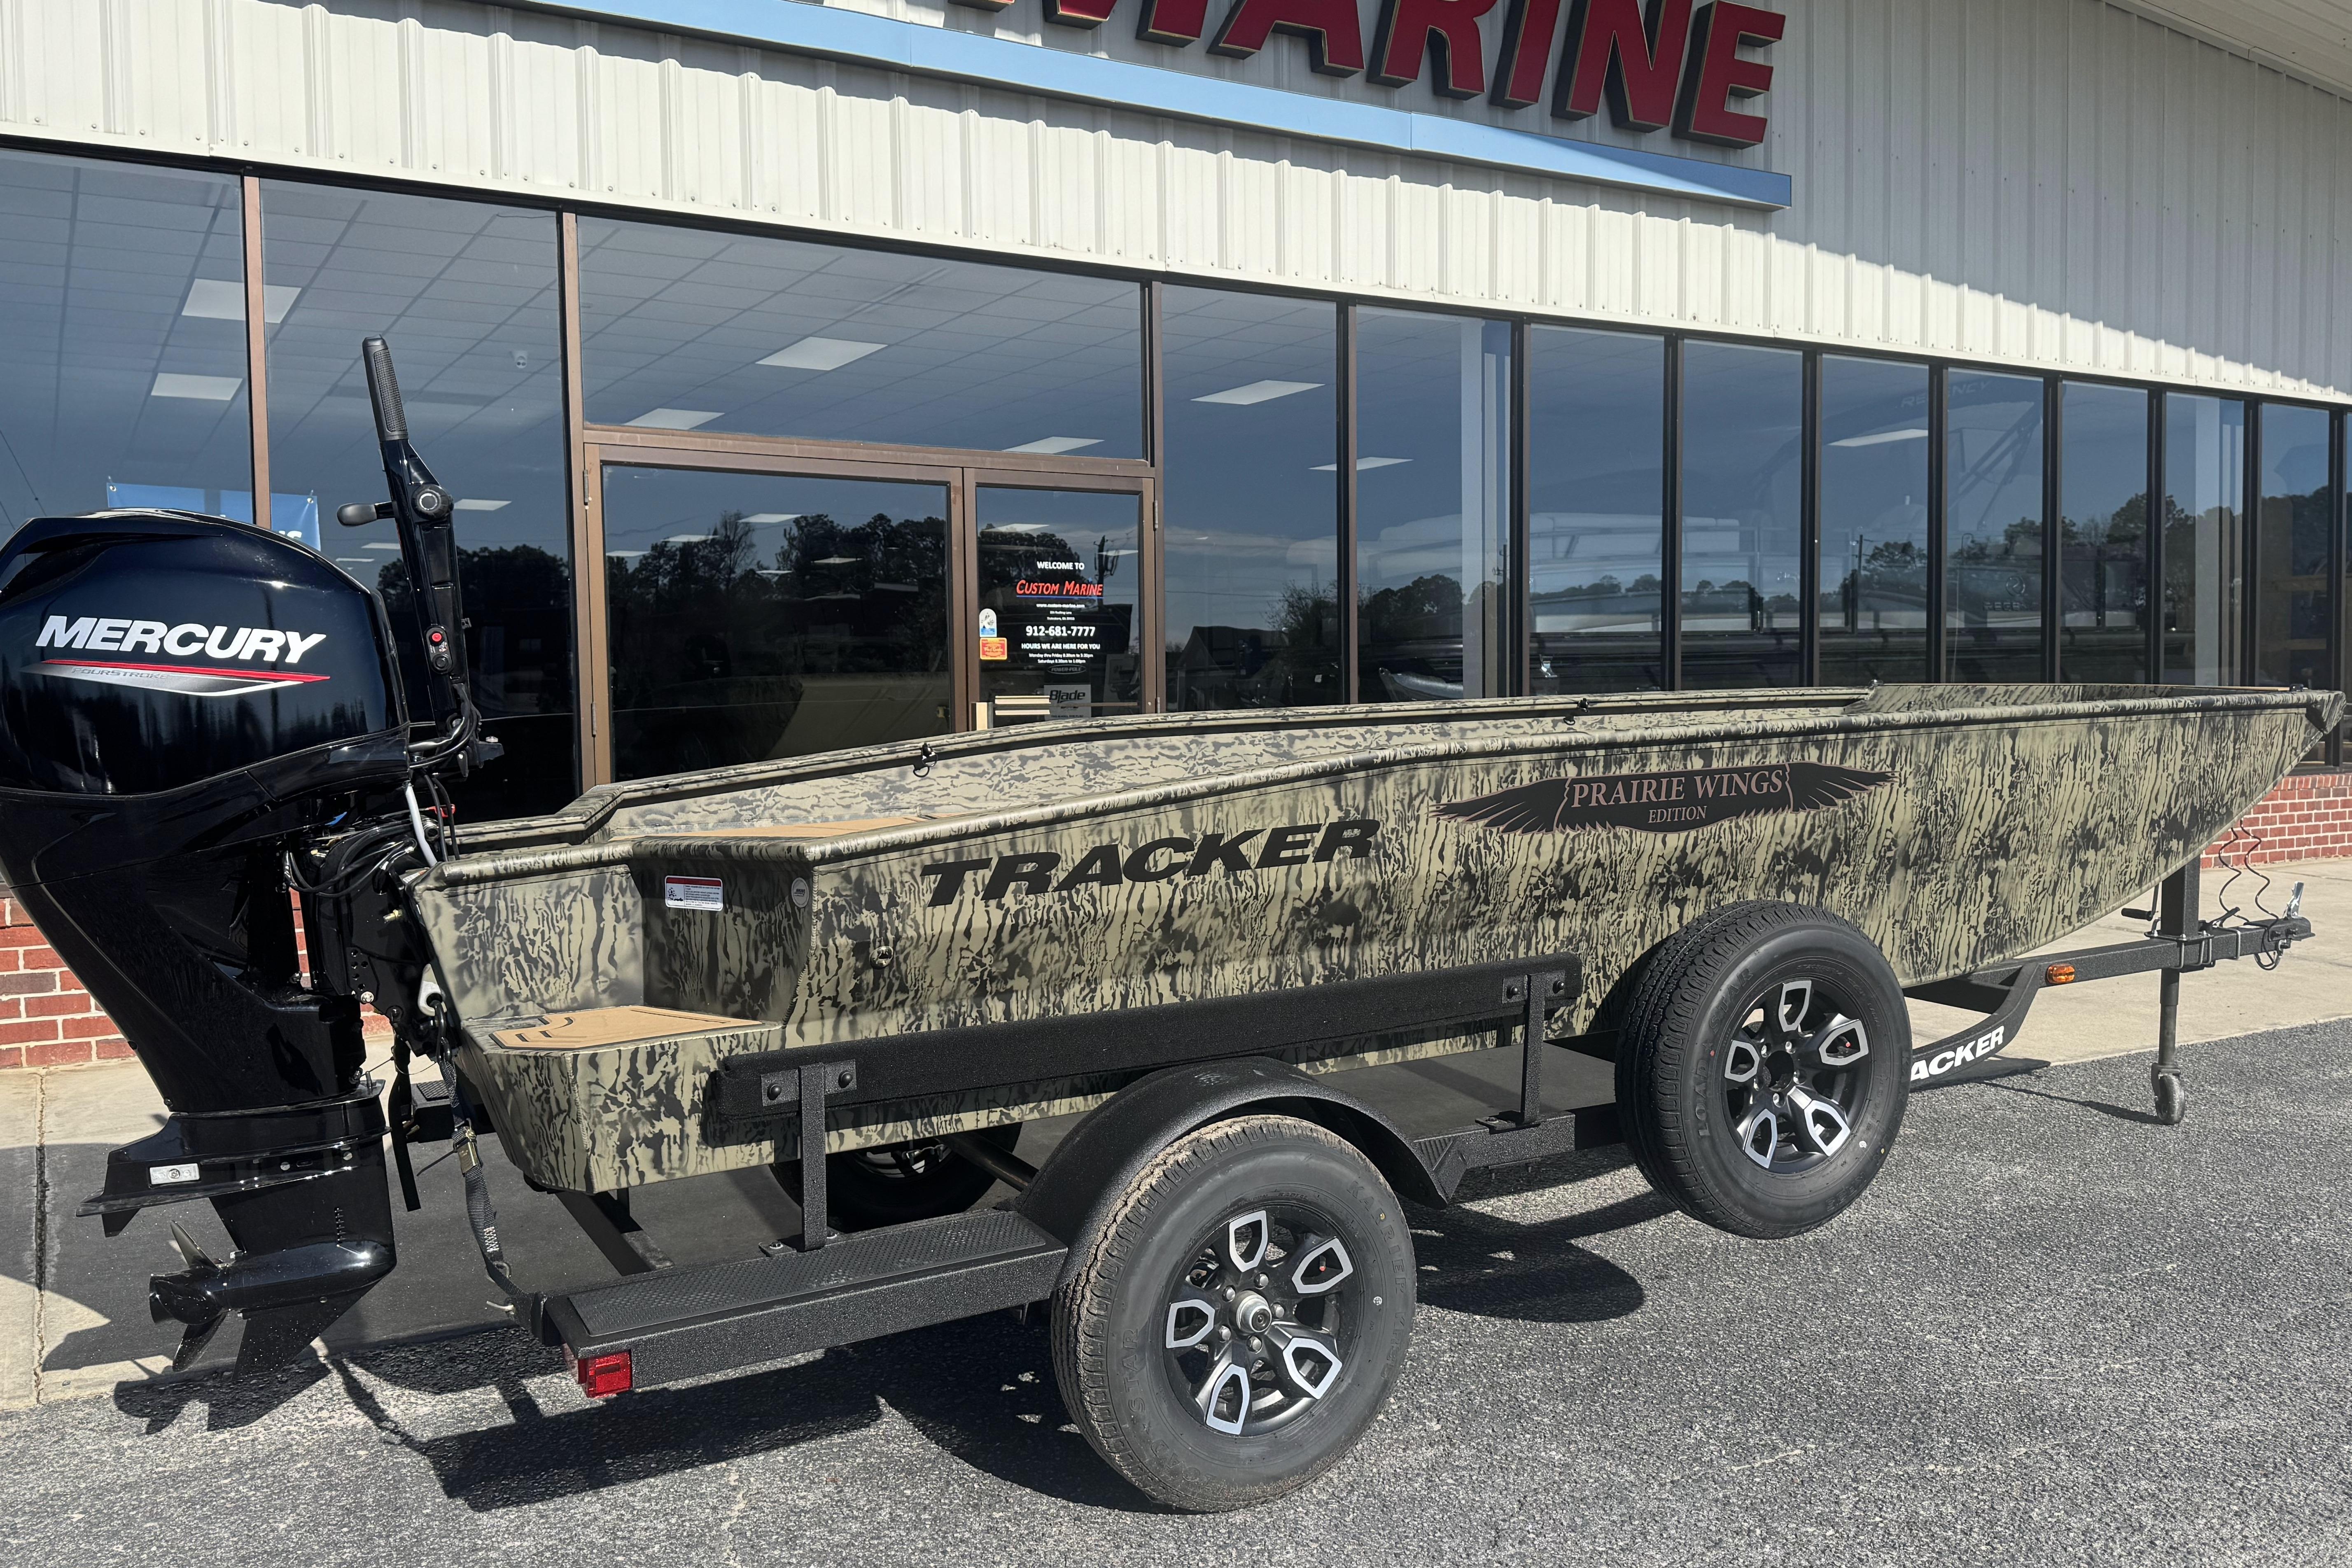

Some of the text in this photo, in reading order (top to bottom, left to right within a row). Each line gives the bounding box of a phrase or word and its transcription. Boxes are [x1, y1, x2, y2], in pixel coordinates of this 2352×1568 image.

[1036, 561, 1073, 570] WELCOME
[35, 615, 327, 664] MERCURY
[1026, 625, 1096, 636] 912-681-7777
[1050, 690, 1085, 704] Blade
[1571, 770, 1783, 807] PRAIRIE WINGS
[1647, 805, 1708, 824] EDITION
[920, 819, 1380, 907] TRACKER
[1911, 1025, 2004, 1081] ACKER
